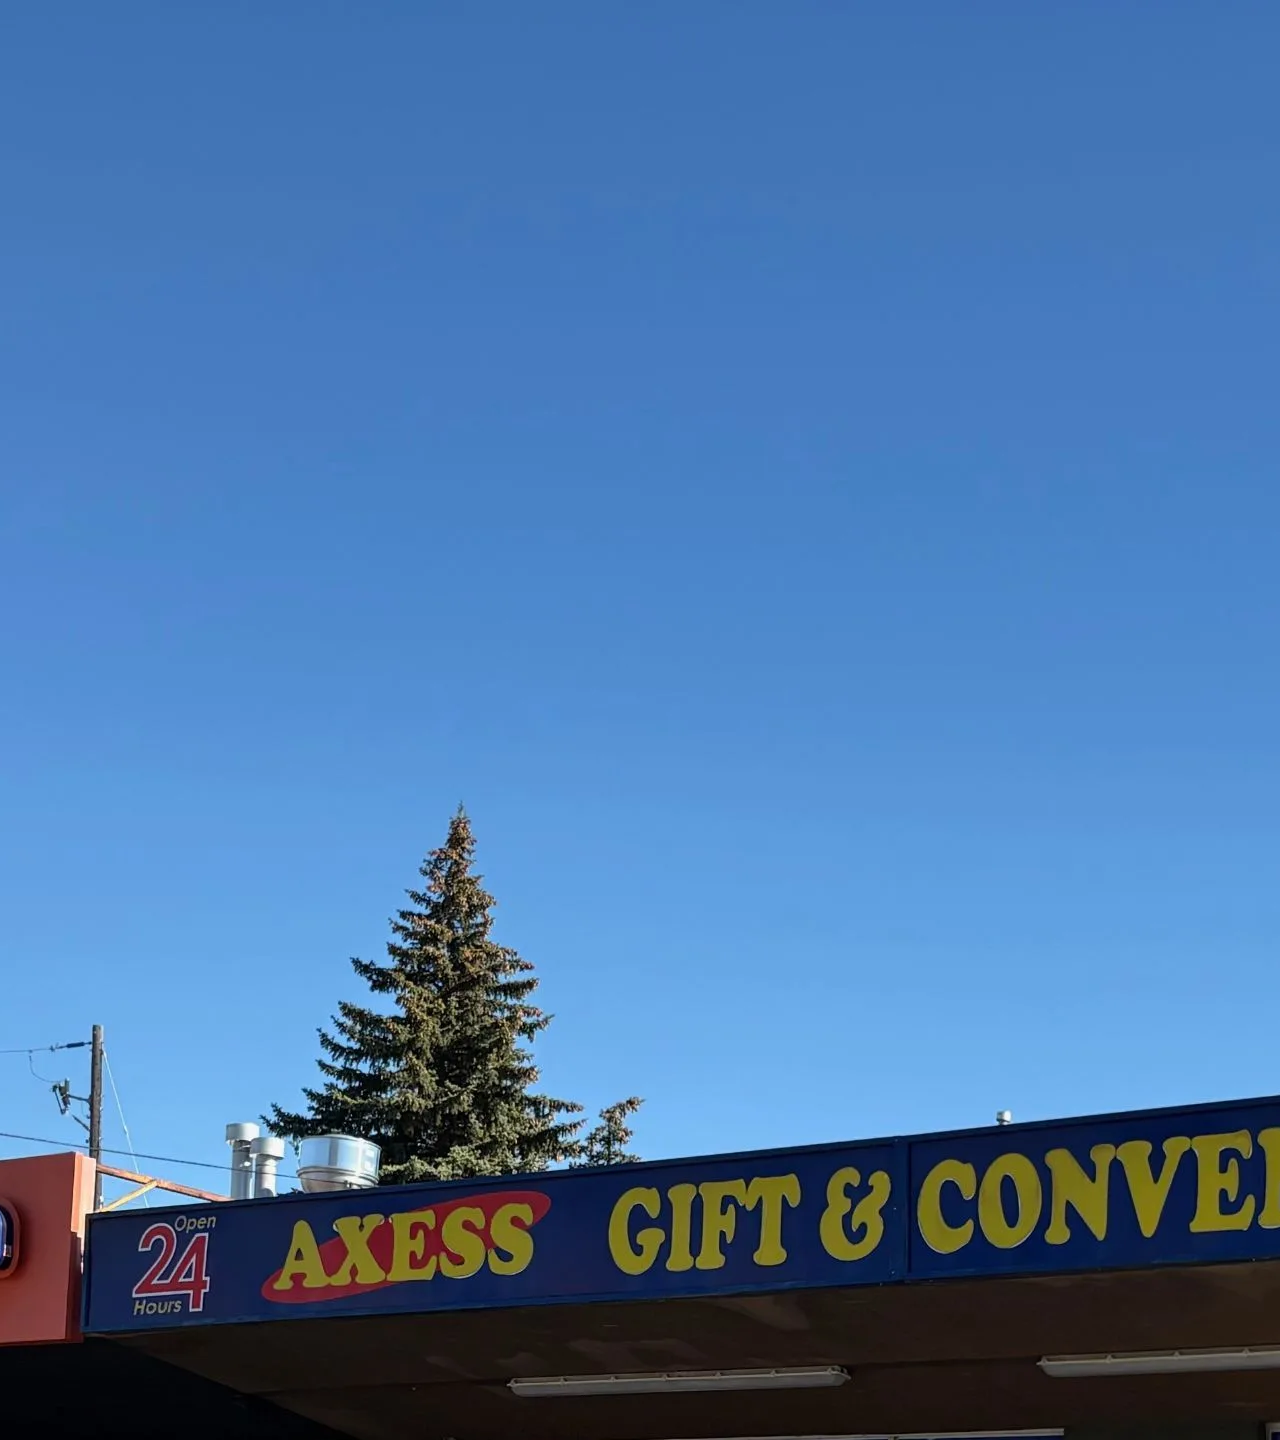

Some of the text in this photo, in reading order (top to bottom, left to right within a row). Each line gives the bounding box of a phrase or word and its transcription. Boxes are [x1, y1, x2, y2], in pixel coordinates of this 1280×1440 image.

[174, 1215, 217, 1234] Open
[273, 1203, 535, 1290] AXESS
[608, 1173, 801, 1276] GIFT
[820, 1166, 892, 1261] &
[132, 1221, 210, 1312] 24
[133, 1300, 182, 1316] Hours
